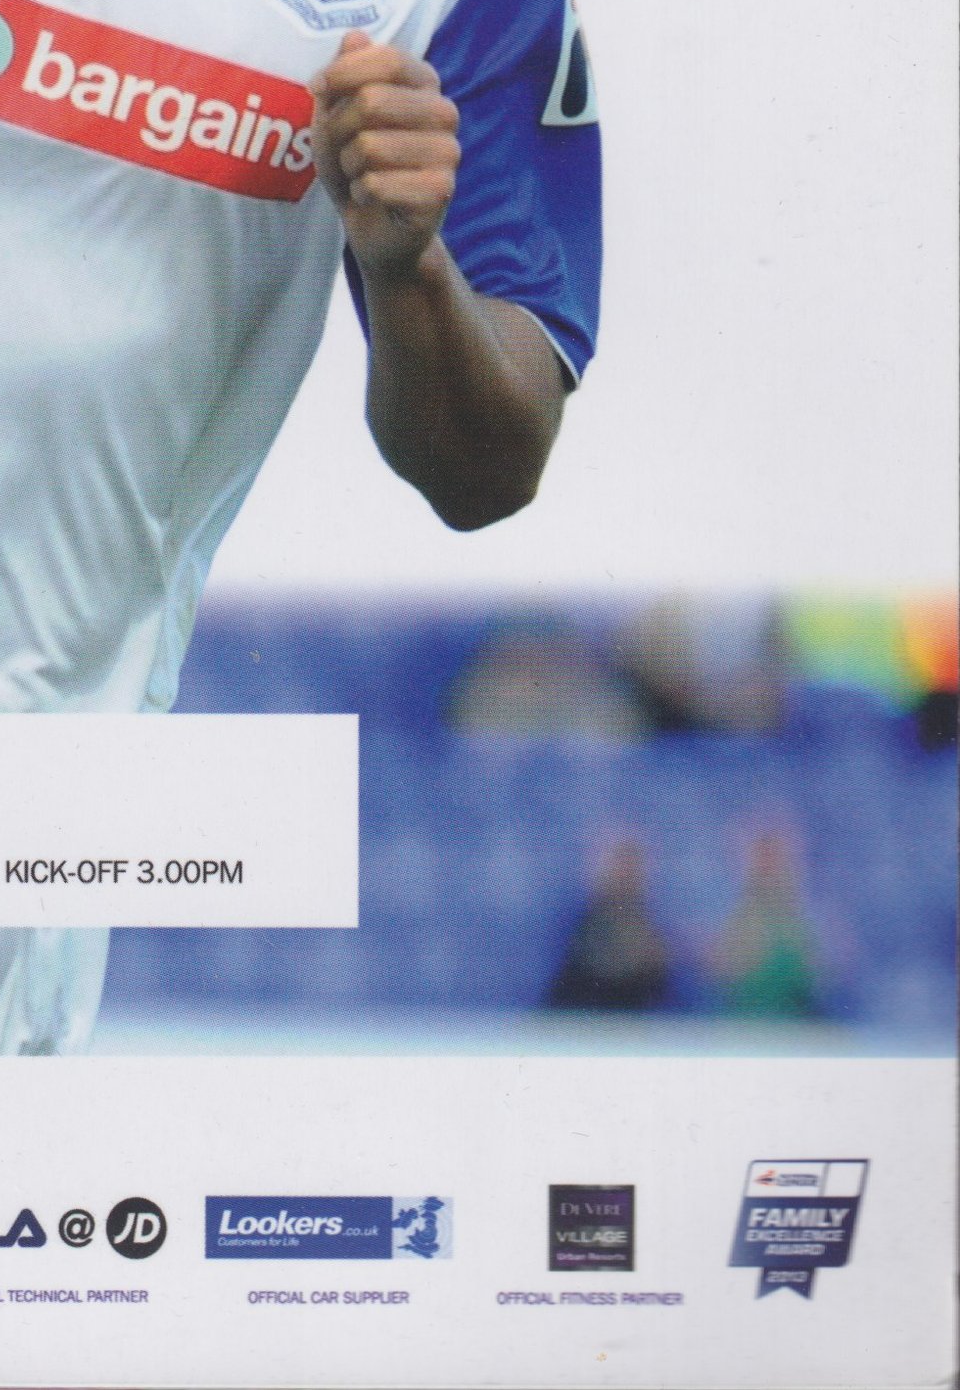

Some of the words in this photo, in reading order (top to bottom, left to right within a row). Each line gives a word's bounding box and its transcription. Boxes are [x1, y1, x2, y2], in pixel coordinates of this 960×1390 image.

[22, 31, 314, 172] bargains
[6, 860, 128, 883] KICK-OFF
[137, 860, 242, 883] 3.00PM
[749, 1208, 849, 1227] FAMILY
[113, 1212, 161, 1244] JD
[218, 1238, 267, 1246] Customers
[269, 1238, 281, 1246] for
[283, 1238, 300, 1246] Life
[556, 1231, 627, 1243] VILLAGE
[8, 1290, 83, 1303] TECHNICAL
[87, 1290, 148, 1303] PARTNER
[248, 1291, 306, 1304] OFFICIAL
[311, 1291, 338, 1304] CAR
[344, 1291, 409, 1304] SUPPLIER
[497, 1292, 556, 1305] OFFICIAL
[560, 1292, 617, 1305] FITNESS
[622, 1293, 683, 1306] PARTNER
